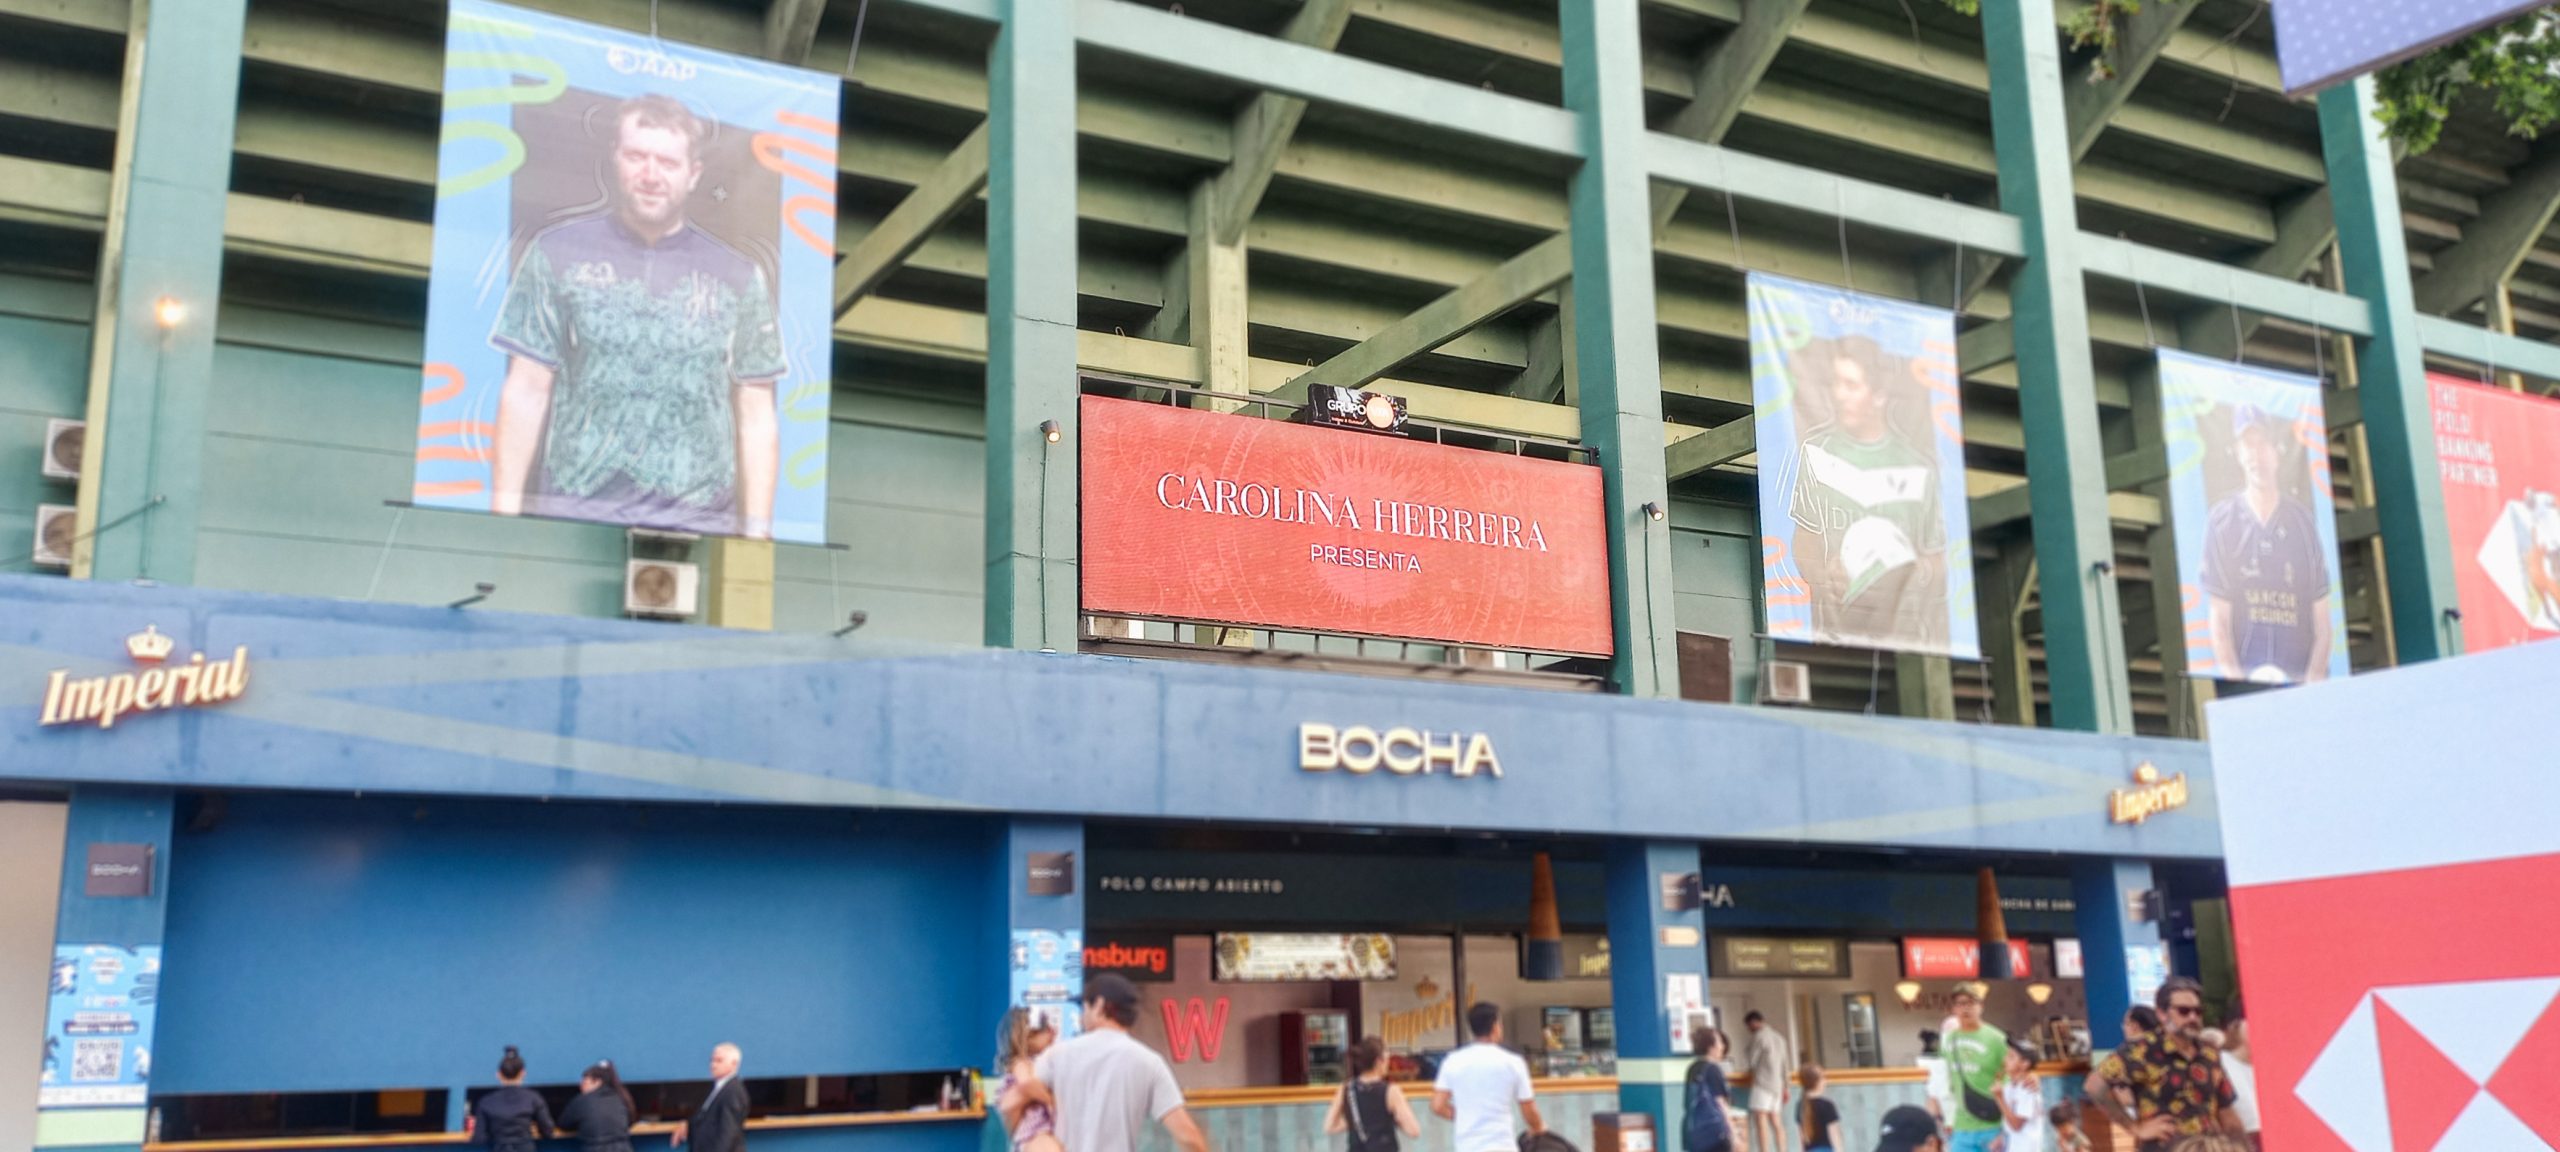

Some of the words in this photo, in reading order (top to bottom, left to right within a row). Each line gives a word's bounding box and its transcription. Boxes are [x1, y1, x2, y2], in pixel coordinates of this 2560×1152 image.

[1327, 399, 1367, 416] GRUPO
[2434, 383, 2459, 409] THE
[2436, 408, 2470, 433] POLO
[2437, 434, 2493, 464] BANKING
[2439, 460, 2499, 487] PARTNER
[1156, 472, 1361, 530] CAROLINA
[1374, 499, 1548, 552] HERRERA
[1311, 543, 1422, 574] PRESENTA
[39, 645, 248, 728] Imperial
[1299, 723, 1504, 778] BOCHA
[1101, 876, 1146, 890] POLO
[1152, 877, 1210, 891] CAMPO
[1214, 879, 1284, 893] ABIERTO
[1161, 996, 1230, 1063] W
